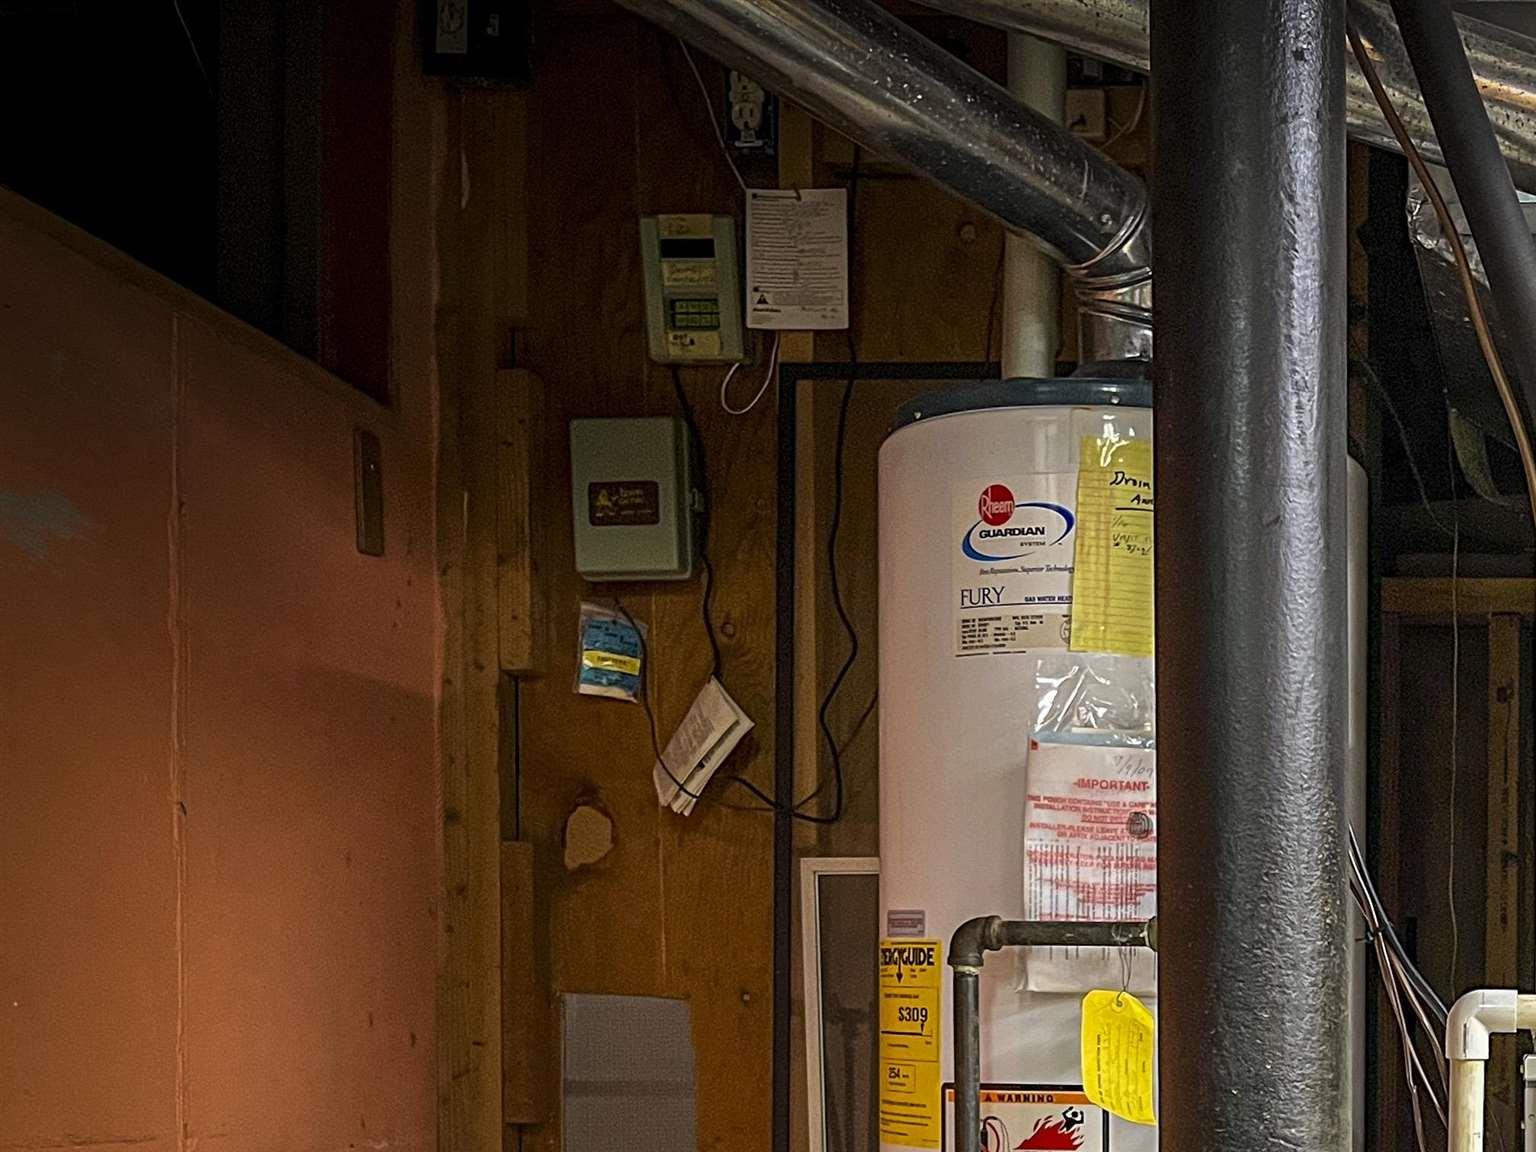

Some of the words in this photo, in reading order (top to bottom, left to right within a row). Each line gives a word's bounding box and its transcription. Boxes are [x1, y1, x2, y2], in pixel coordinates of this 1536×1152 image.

[1109, 471, 1151, 490] Drain
[979, 526, 1045, 538] GUARDIAN
[960, 586, 1005, 606] FURY
[898, 1007, 928, 1023] $309
[996, 1094, 1054, 1103] WARNING
